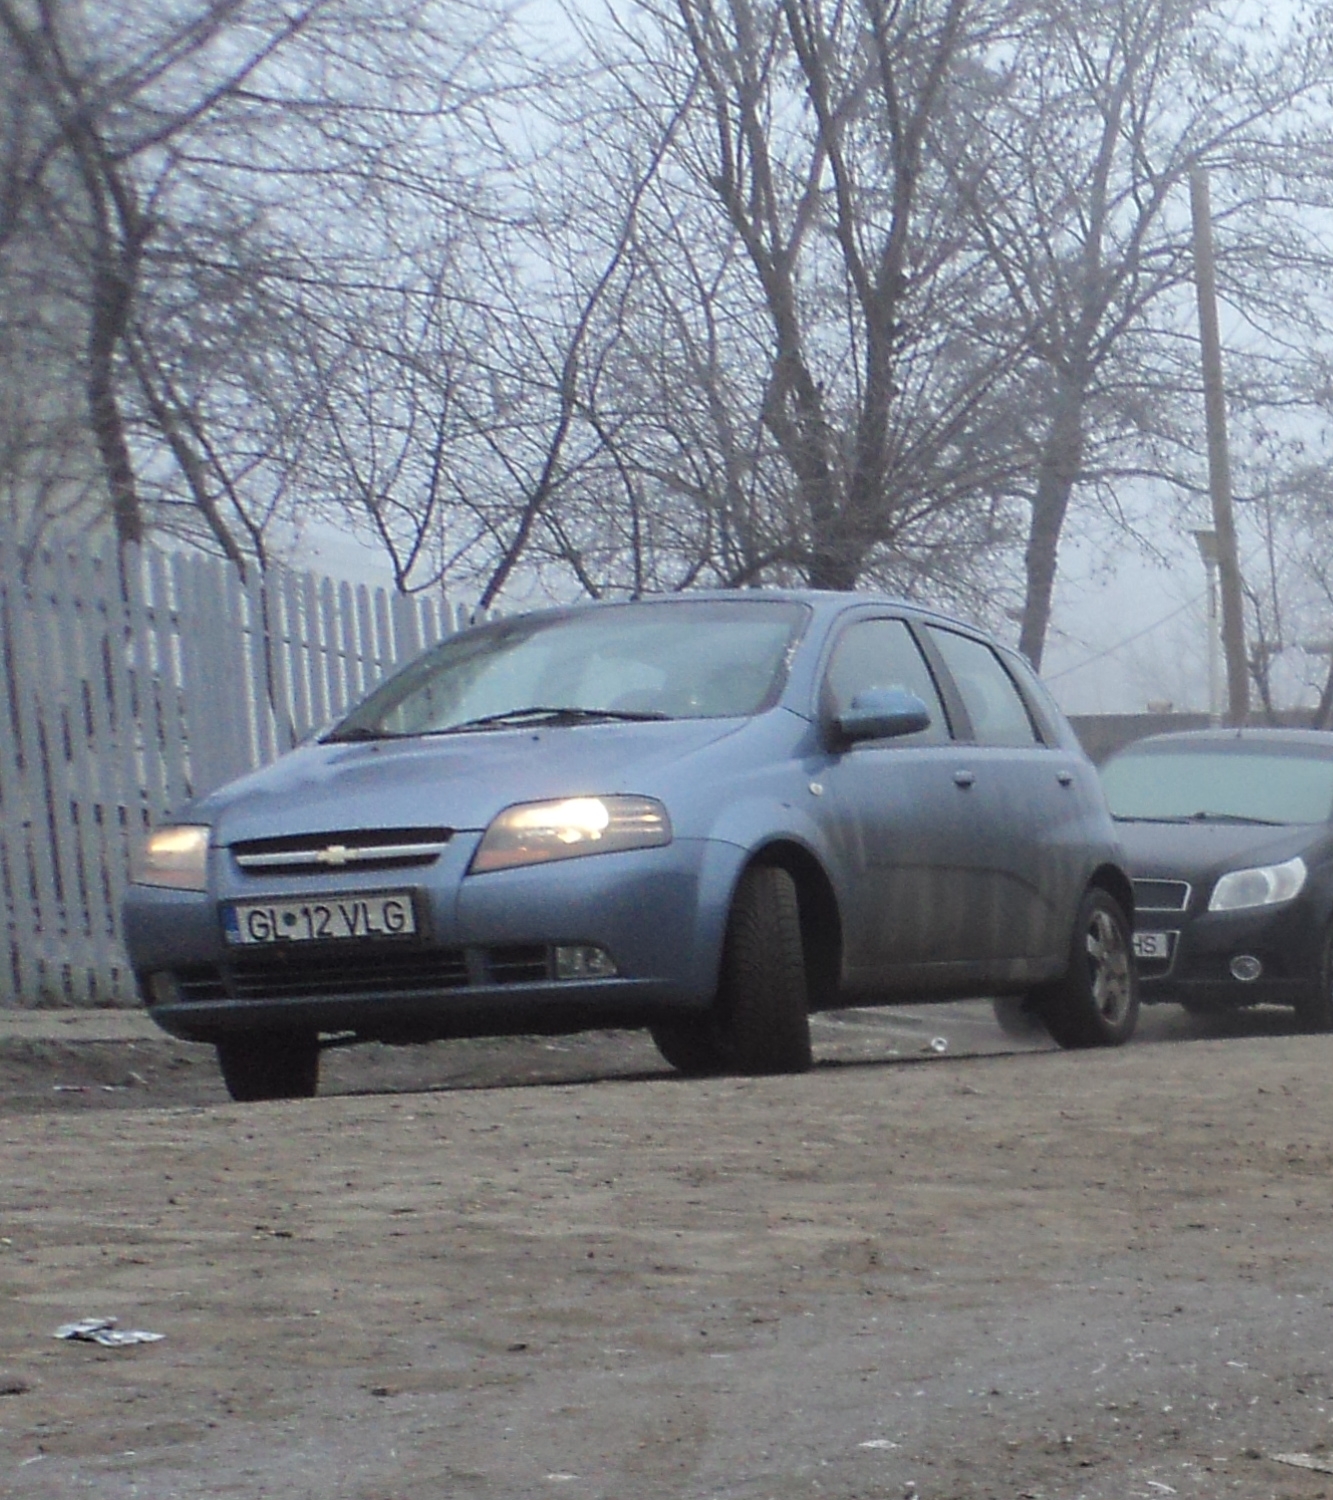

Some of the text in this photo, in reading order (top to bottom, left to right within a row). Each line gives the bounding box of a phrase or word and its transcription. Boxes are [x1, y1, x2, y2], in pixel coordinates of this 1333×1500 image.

[249, 901, 405, 941] GL 12 VLG
